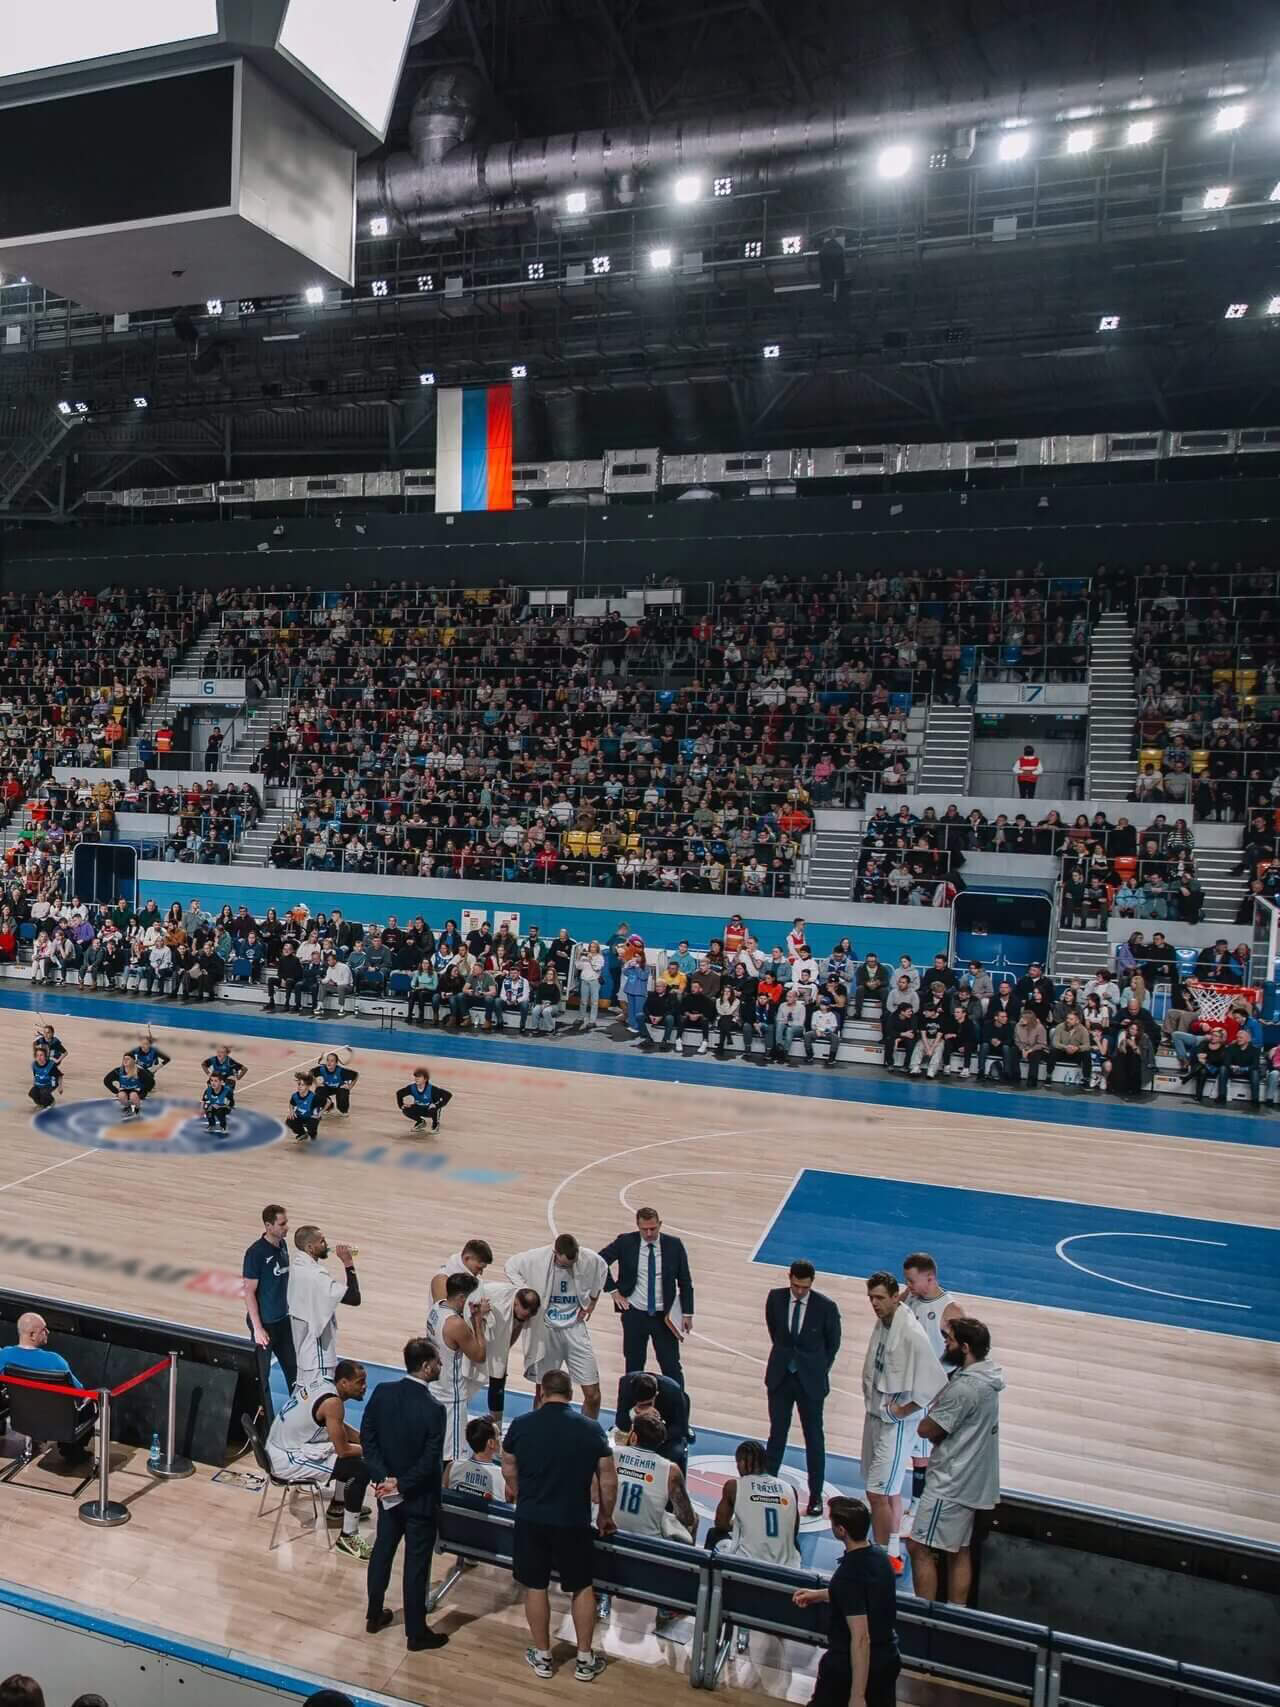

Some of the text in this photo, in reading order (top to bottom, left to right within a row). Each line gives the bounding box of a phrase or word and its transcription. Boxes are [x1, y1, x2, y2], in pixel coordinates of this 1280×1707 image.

[203, 681, 214, 695] 6
[1026, 685, 1042, 702] 7
[560, 1280, 568, 1293] 8
[550, 1296, 577, 1304] ENI
[619, 1454, 656, 1470] MOERMAN
[620, 1481, 643, 1515] 18
[765, 1507, 778, 1537] 0
